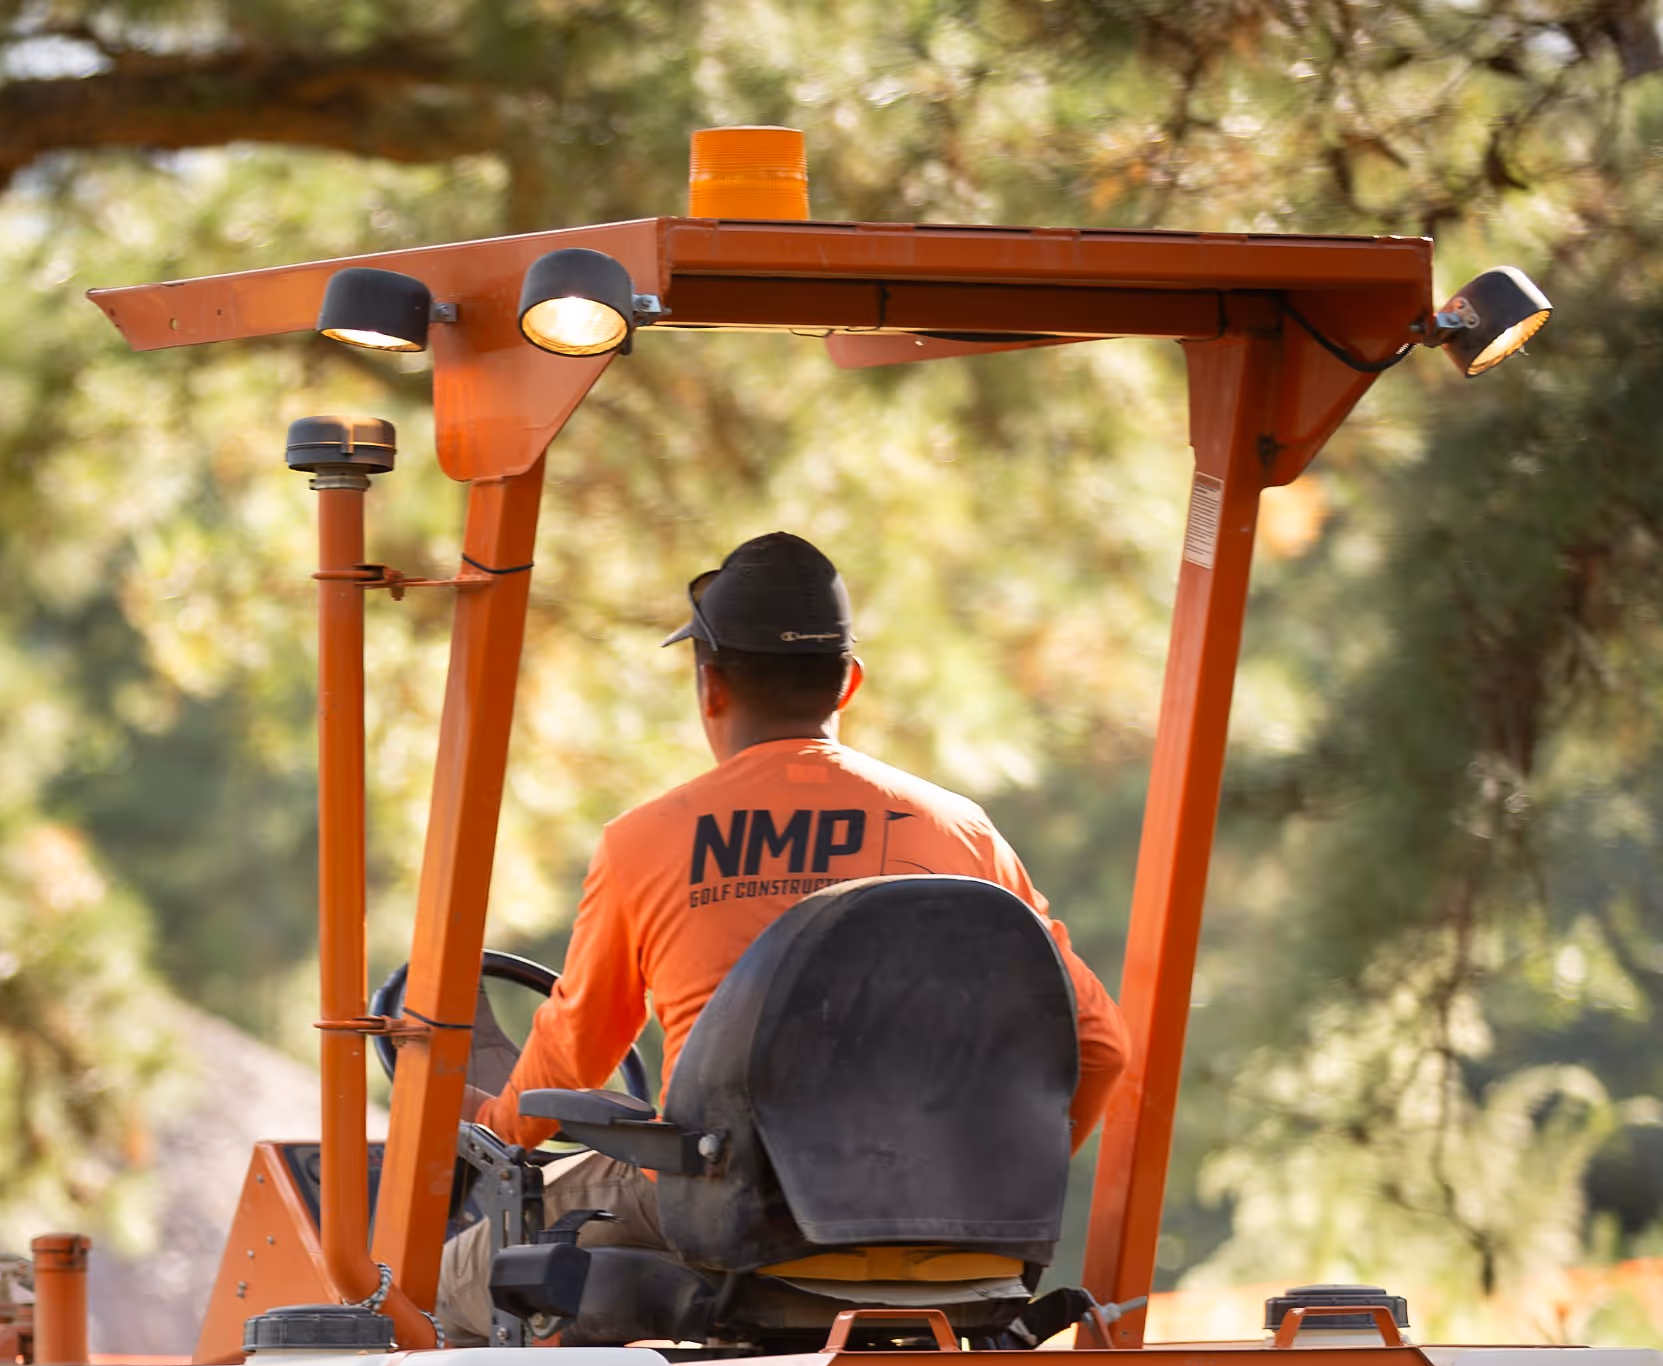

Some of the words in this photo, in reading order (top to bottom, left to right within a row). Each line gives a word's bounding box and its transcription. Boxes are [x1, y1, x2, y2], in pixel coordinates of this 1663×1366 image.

[690, 809, 866, 884] NMP
[690, 884, 731, 908] GOLF
[736, 878, 850, 899] CONSTRUCT
